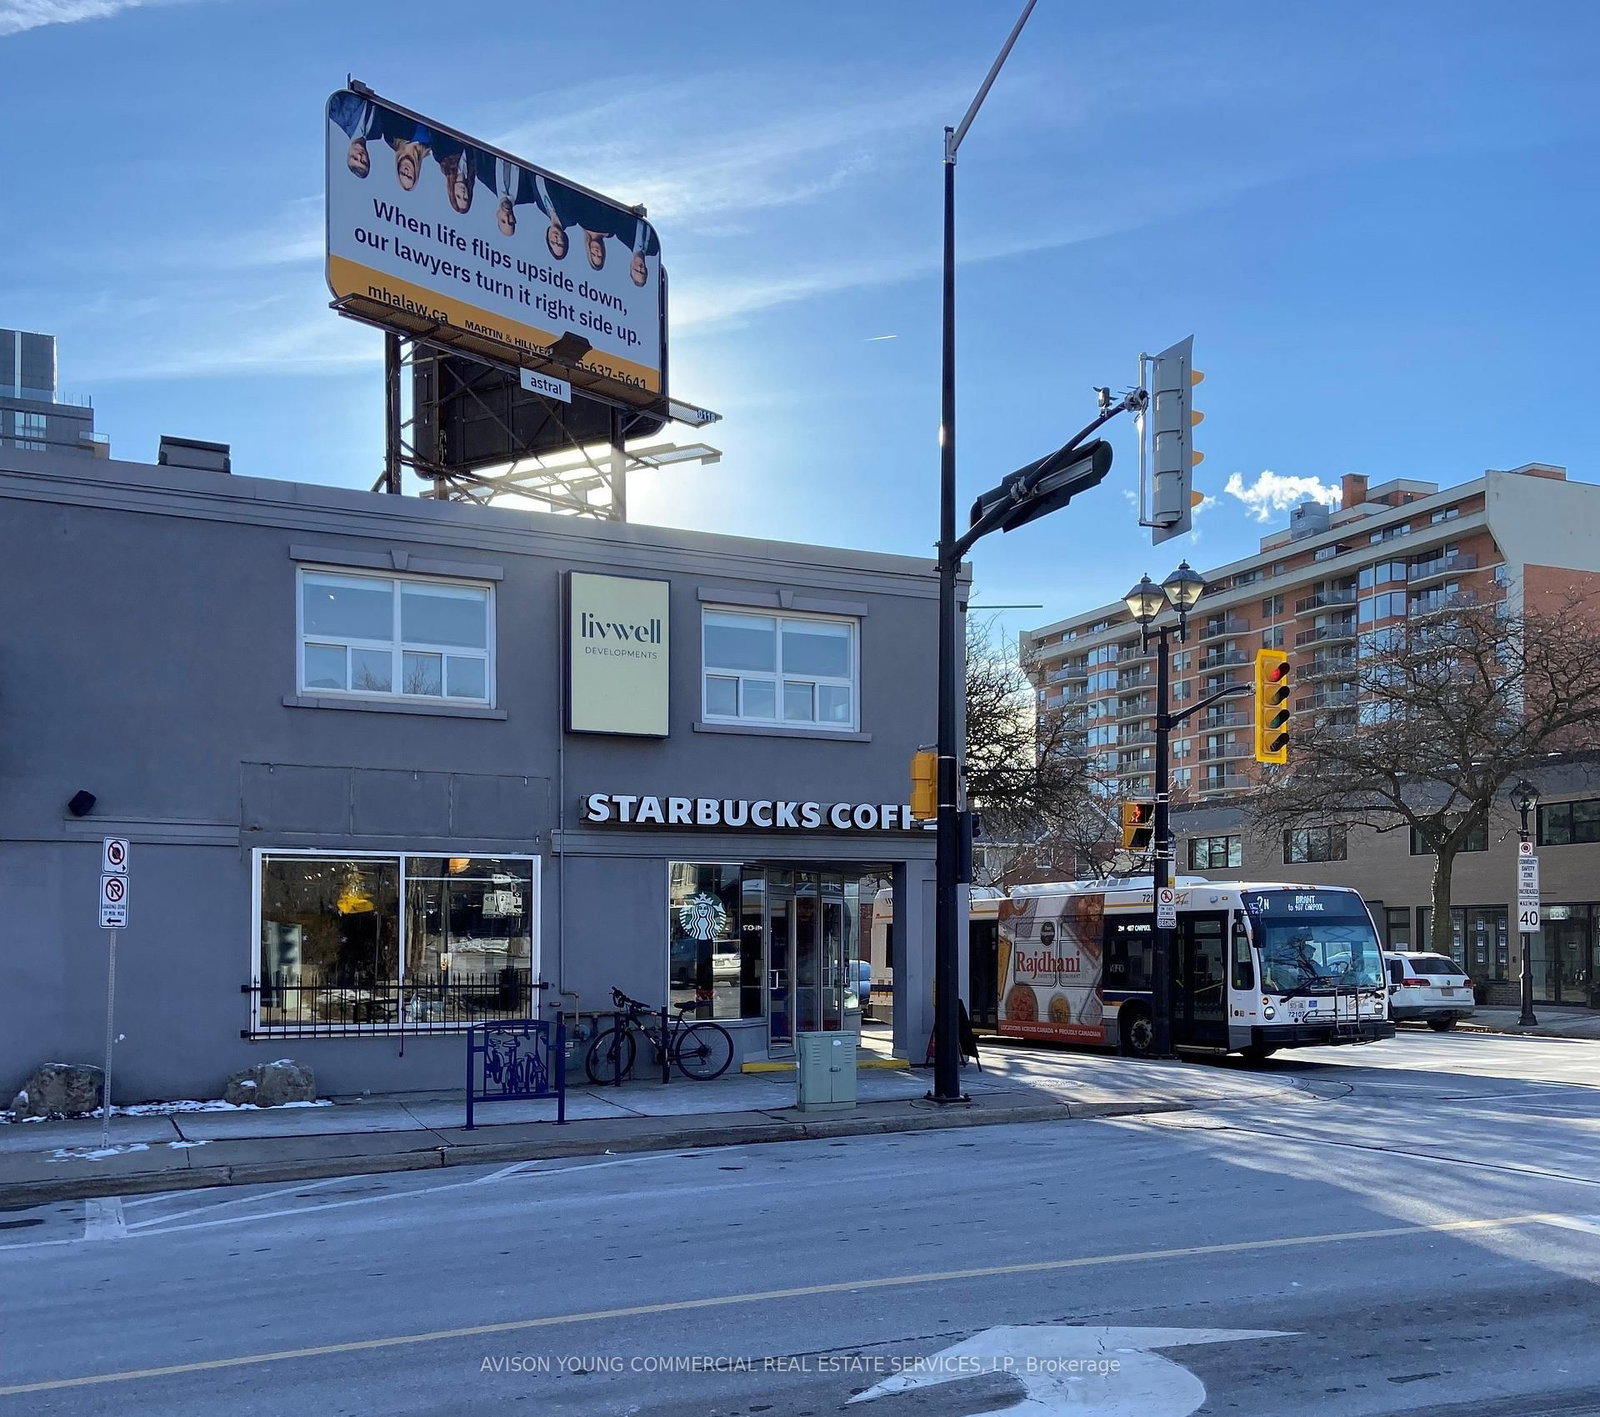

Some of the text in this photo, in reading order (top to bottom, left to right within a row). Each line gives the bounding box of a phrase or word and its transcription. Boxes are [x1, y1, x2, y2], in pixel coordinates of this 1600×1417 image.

[373, 198, 627, 316] When life flips upside down,
[354, 228, 641, 346] our lawyers turn it right side up.
[368, 285, 448, 323] mhalaw.ca
[464, 320, 503, 340] MARTIN
[505, 334, 513, 343] &
[575, 358, 646, 389] 5-637-5641
[530, 377, 562, 395] astral
[581, 612, 661, 644] livwell
[585, 646, 658, 659] DEVELOPMENTS
[586, 793, 821, 829] STARBUCKS
[1287, 903, 1325, 911] to 407 CARPOOL
[1295, 895, 1315, 904] BRANT
[1134, 924, 1152, 932] CARPOOL
[1158, 919, 1176, 927] BEGINS
[1520, 911, 1538, 926] 40
[1015, 950, 1081, 979] Rajdhani
[1058, 1028, 1078, 1036] PROUDLY
[1078, 1030, 1102, 1038] CANADIAN
